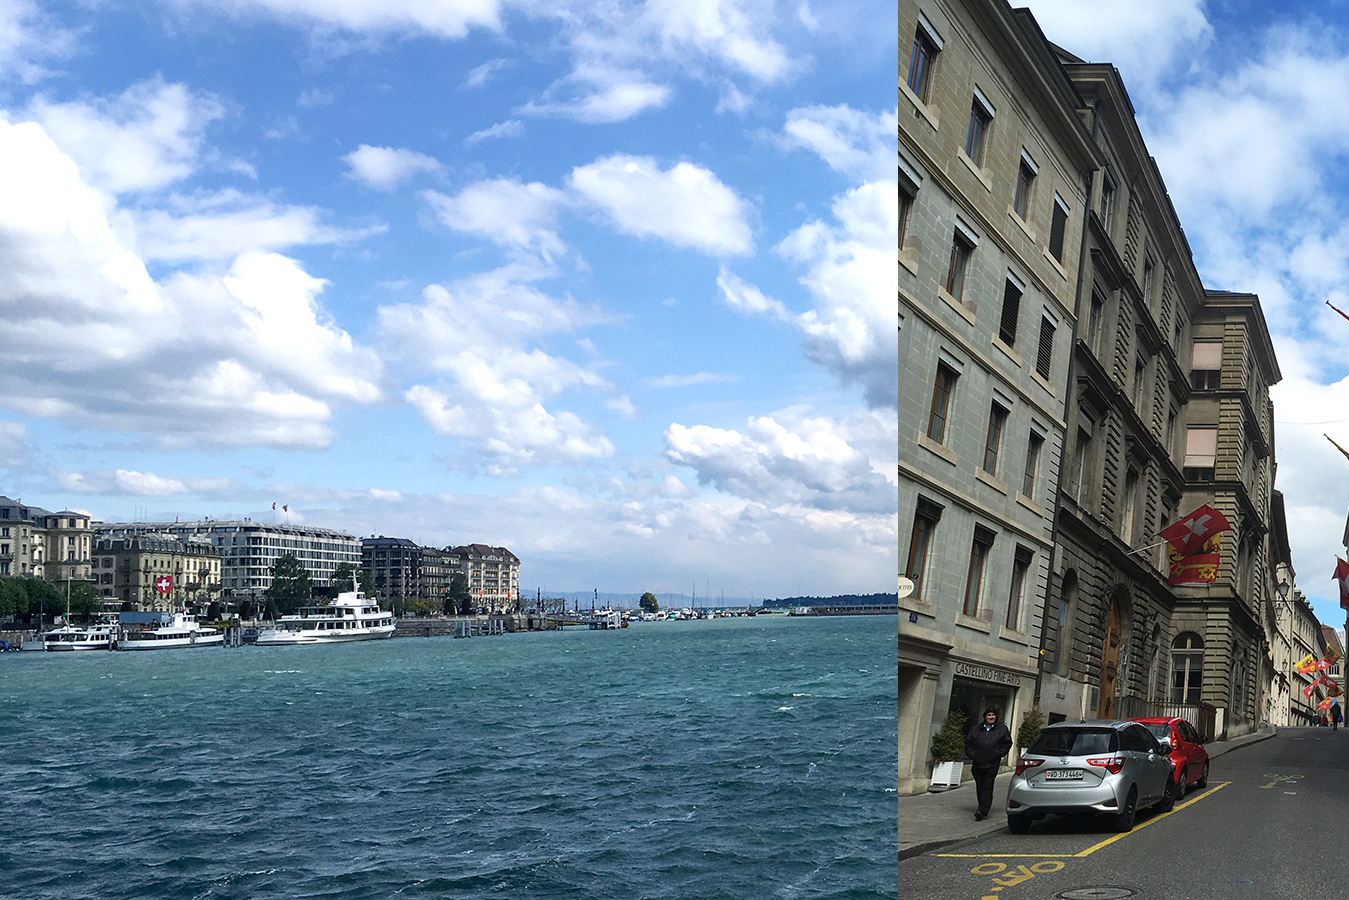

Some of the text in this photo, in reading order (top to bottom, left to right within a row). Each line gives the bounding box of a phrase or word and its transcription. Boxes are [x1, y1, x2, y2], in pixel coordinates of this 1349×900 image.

[956, 662, 1021, 685] CASTELLINO FINE ARTS
